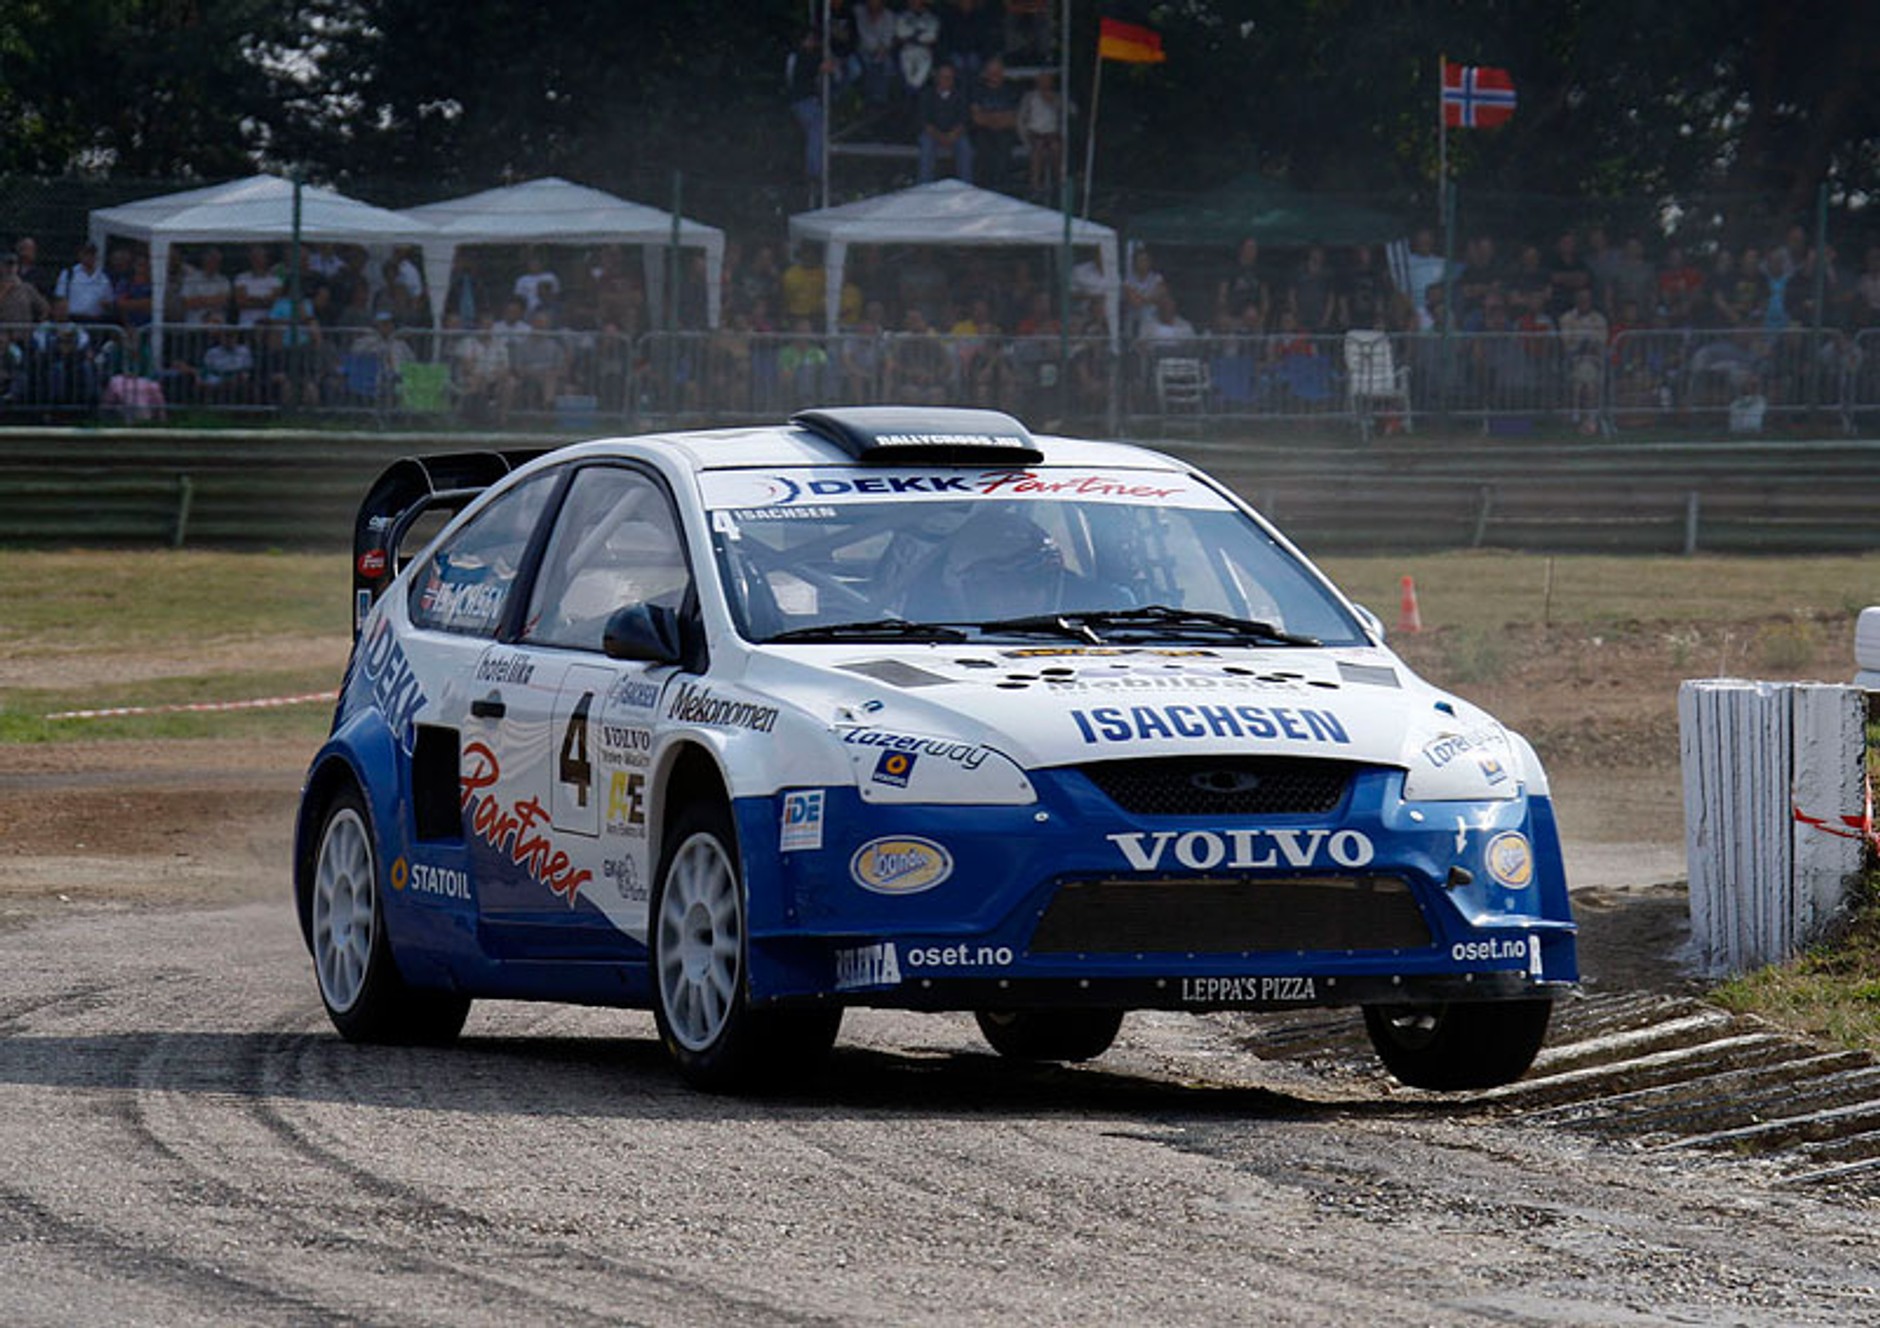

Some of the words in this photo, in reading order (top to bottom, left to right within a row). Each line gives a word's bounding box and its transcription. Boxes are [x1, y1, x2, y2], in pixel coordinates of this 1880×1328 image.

[809, 477, 972, 494] DEKK
[977, 471, 1187, 498] Partner
[712, 510, 742, 540] 4
[667, 682, 779, 734] Mekonomen
[603, 726, 650, 750] VOLVO
[1071, 706, 1351, 744] ISACHSEN
[560, 691, 594, 808] 4
[460, 742, 592, 904] Partner
[1106, 830, 1374, 871] VOLVO
[411, 864, 472, 899] STATOIL
[908, 943, 1013, 966] oset.no
[1452, 938, 1526, 960] oset.no
[1181, 977, 1257, 1000] LEPPA'S
[1261, 977, 1316, 1000] PIZZA
